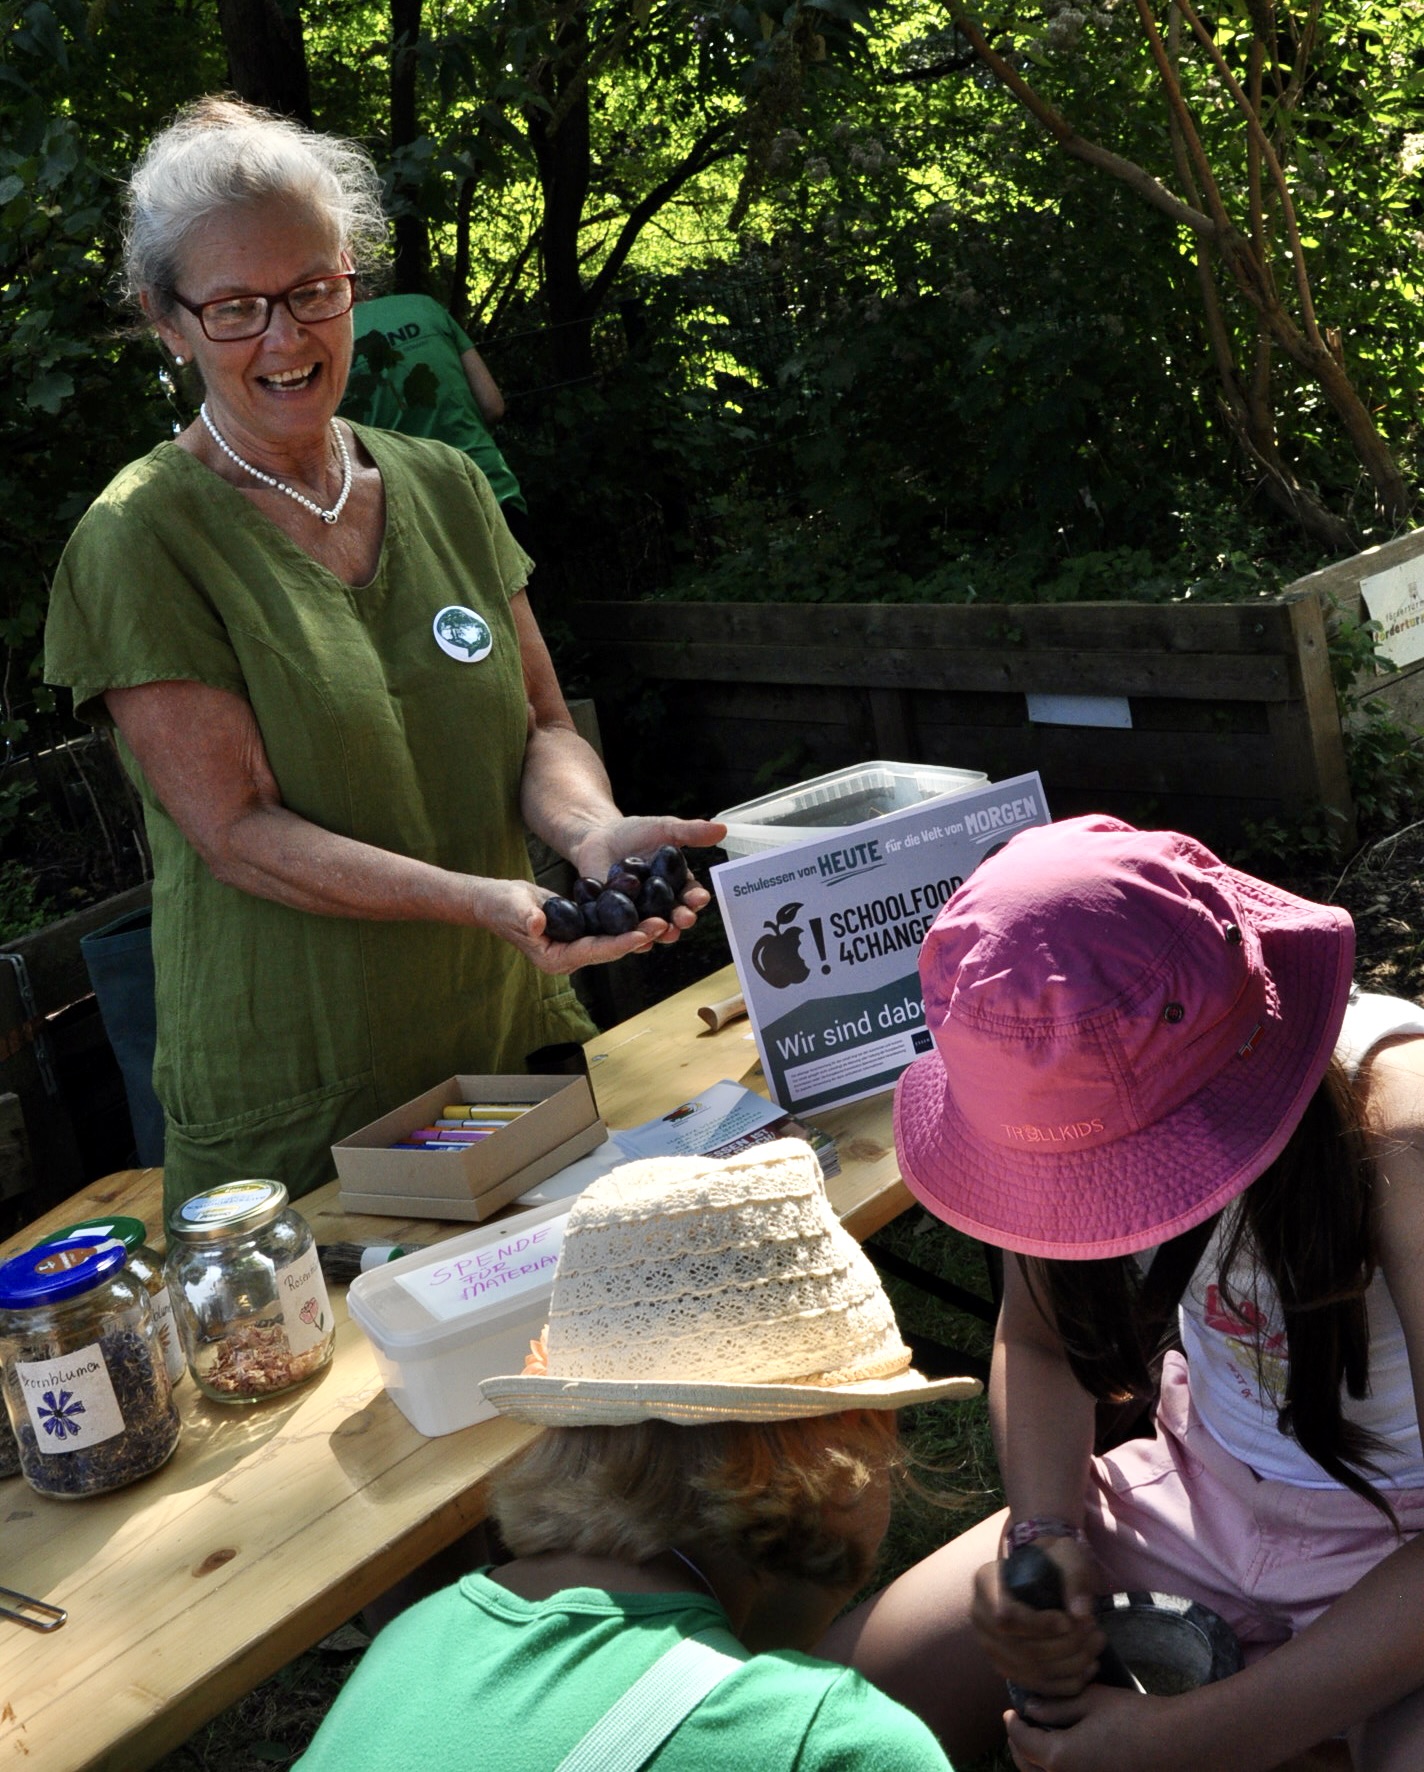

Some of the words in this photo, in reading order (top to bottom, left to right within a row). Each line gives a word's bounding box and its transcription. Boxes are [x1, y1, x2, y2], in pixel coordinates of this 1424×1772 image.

[386, 322, 421, 347] ND
[733, 871, 796, 897] Schulessen
[797, 865, 817, 878] von
[817, 840, 882, 877] HEUTE
[885, 838, 901, 853] für
[904, 834, 921, 848] die
[920, 827, 944, 844] Welt
[944, 823, 964, 836] von
[964, 795, 1038, 836] MORGEN
[776, 1031, 816, 1061] Wir
[823, 1010, 872, 1046] sind
[1000, 1118, 1104, 1142] TROLLKIDS
[430, 1227, 552, 1286] SPENDE
[460, 1261, 510, 1284] FÜR
